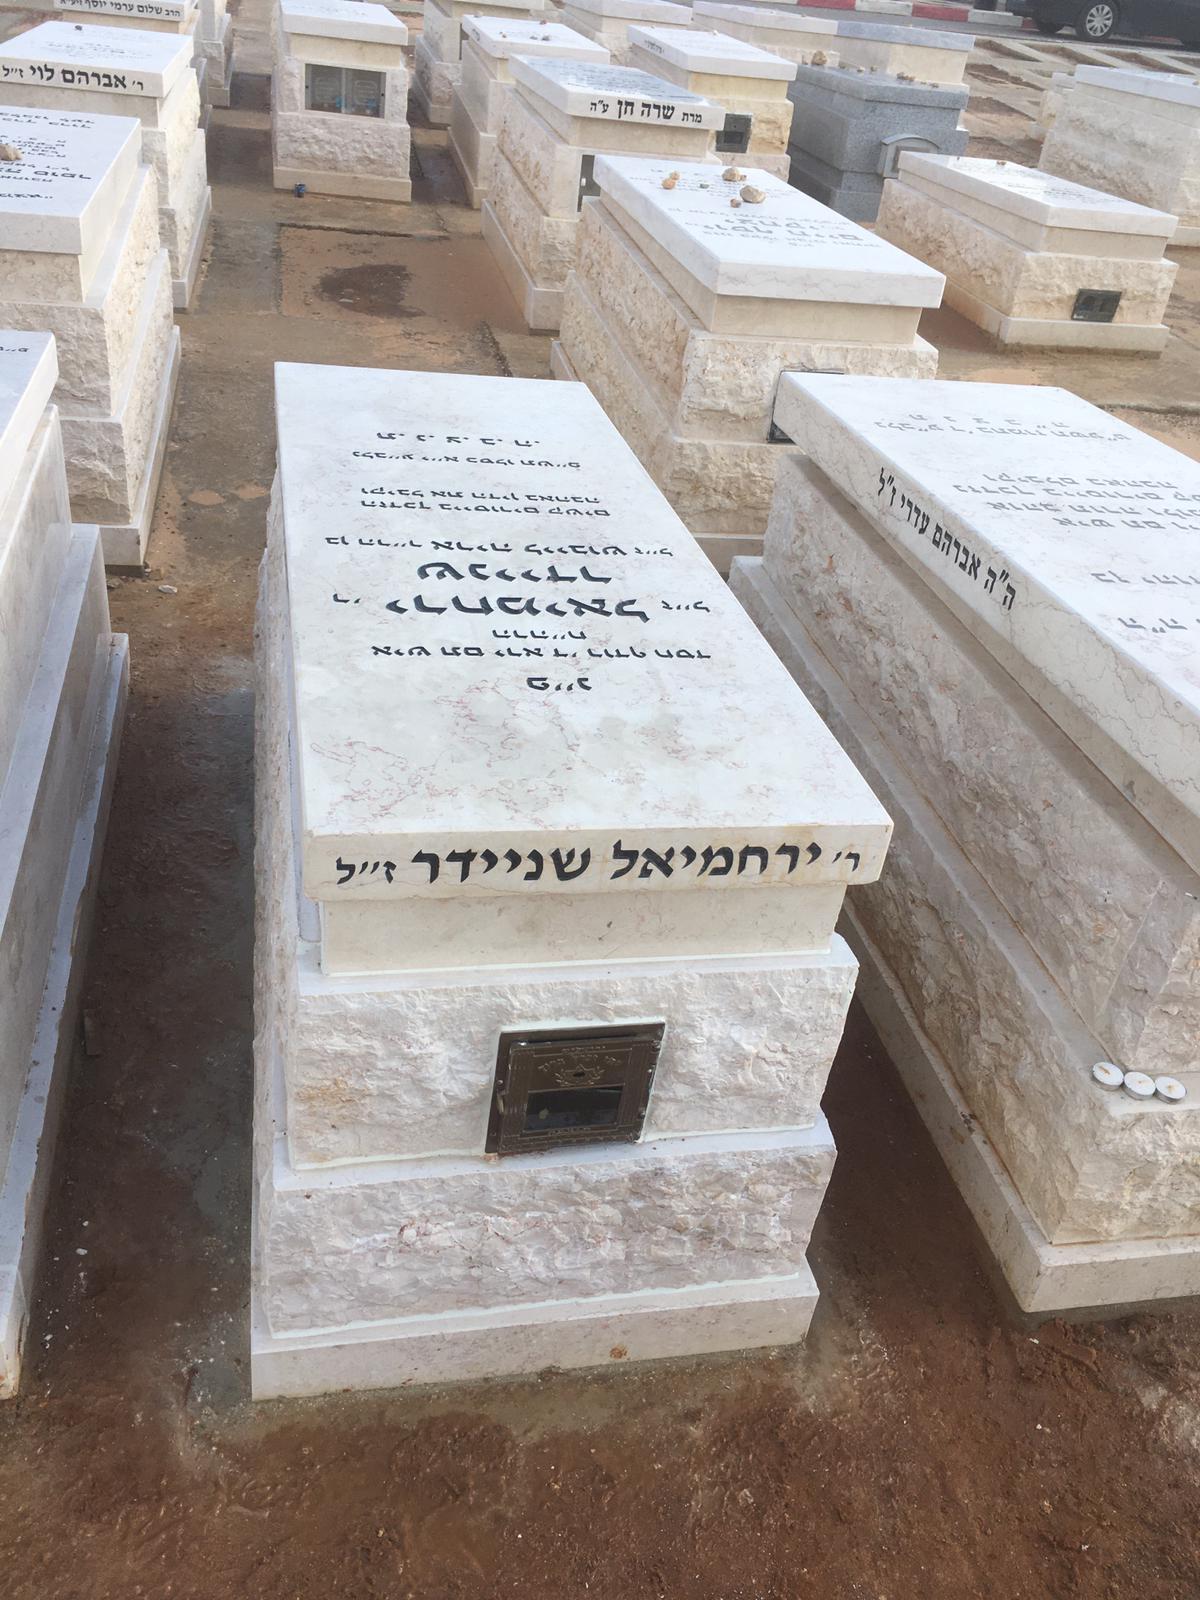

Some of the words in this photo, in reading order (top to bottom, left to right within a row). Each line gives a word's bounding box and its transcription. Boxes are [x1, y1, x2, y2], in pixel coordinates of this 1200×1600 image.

[137, 4, 162, 15] שלום
[165, 9, 180, 17] הרב
[2, 65, 24, 78] ז"ל
[29, 64, 54, 81] לוי
[61, 68, 127, 90] אברהם
[590, 100, 610, 114] ע"ה
[617, 99, 634, 119] חן
[640, 102, 675, 120] שרה
[681, 112, 702, 124] מרת
[976, 426, 1048, 437] בתמוז
[465, 456, 515, 466] כסלו
[982, 472, 1079, 488] וקיבלם
[1086, 478, 1178, 489] באהבה
[360, 486, 425, 498] וקיבל
[430, 490, 464, 499] את
[471, 492, 520, 501] הדין
[524, 494, 601, 504] באהבה
[1042, 488, 1164, 500] בייסורים
[360, 500, 432, 510] הזדכך
[438, 503, 540, 514] בייסורים
[548, 506, 611, 517] קשים
[986, 501, 1062, 512] אוהב
[1068, 504, 1142, 515] תורה
[1052, 517, 1116, 528] איש
[1121, 520, 1166, 530] תם
[324, 535, 350, 546] בן
[430, 540, 513, 553] אריה
[523, 543, 628, 556] לייבוש
[932, 522, 982, 581] אברהם
[416, 561, 613, 585] שניידר
[1090, 570, 1130, 584] בן
[385, 594, 651, 624] ירחמיאל
[370, 645, 432, 657] איש
[440, 646, 486, 658] תם
[494, 647, 544, 658] ירא
[586, 646, 647, 659] רודף
[654, 648, 712, 660] חסד
[410, 846, 593, 884] שניידר
[610, 838, 822, 880] ירחמיאל
[830, 851, 862, 873] ר'
[335, 857, 398, 885] ז"ל
